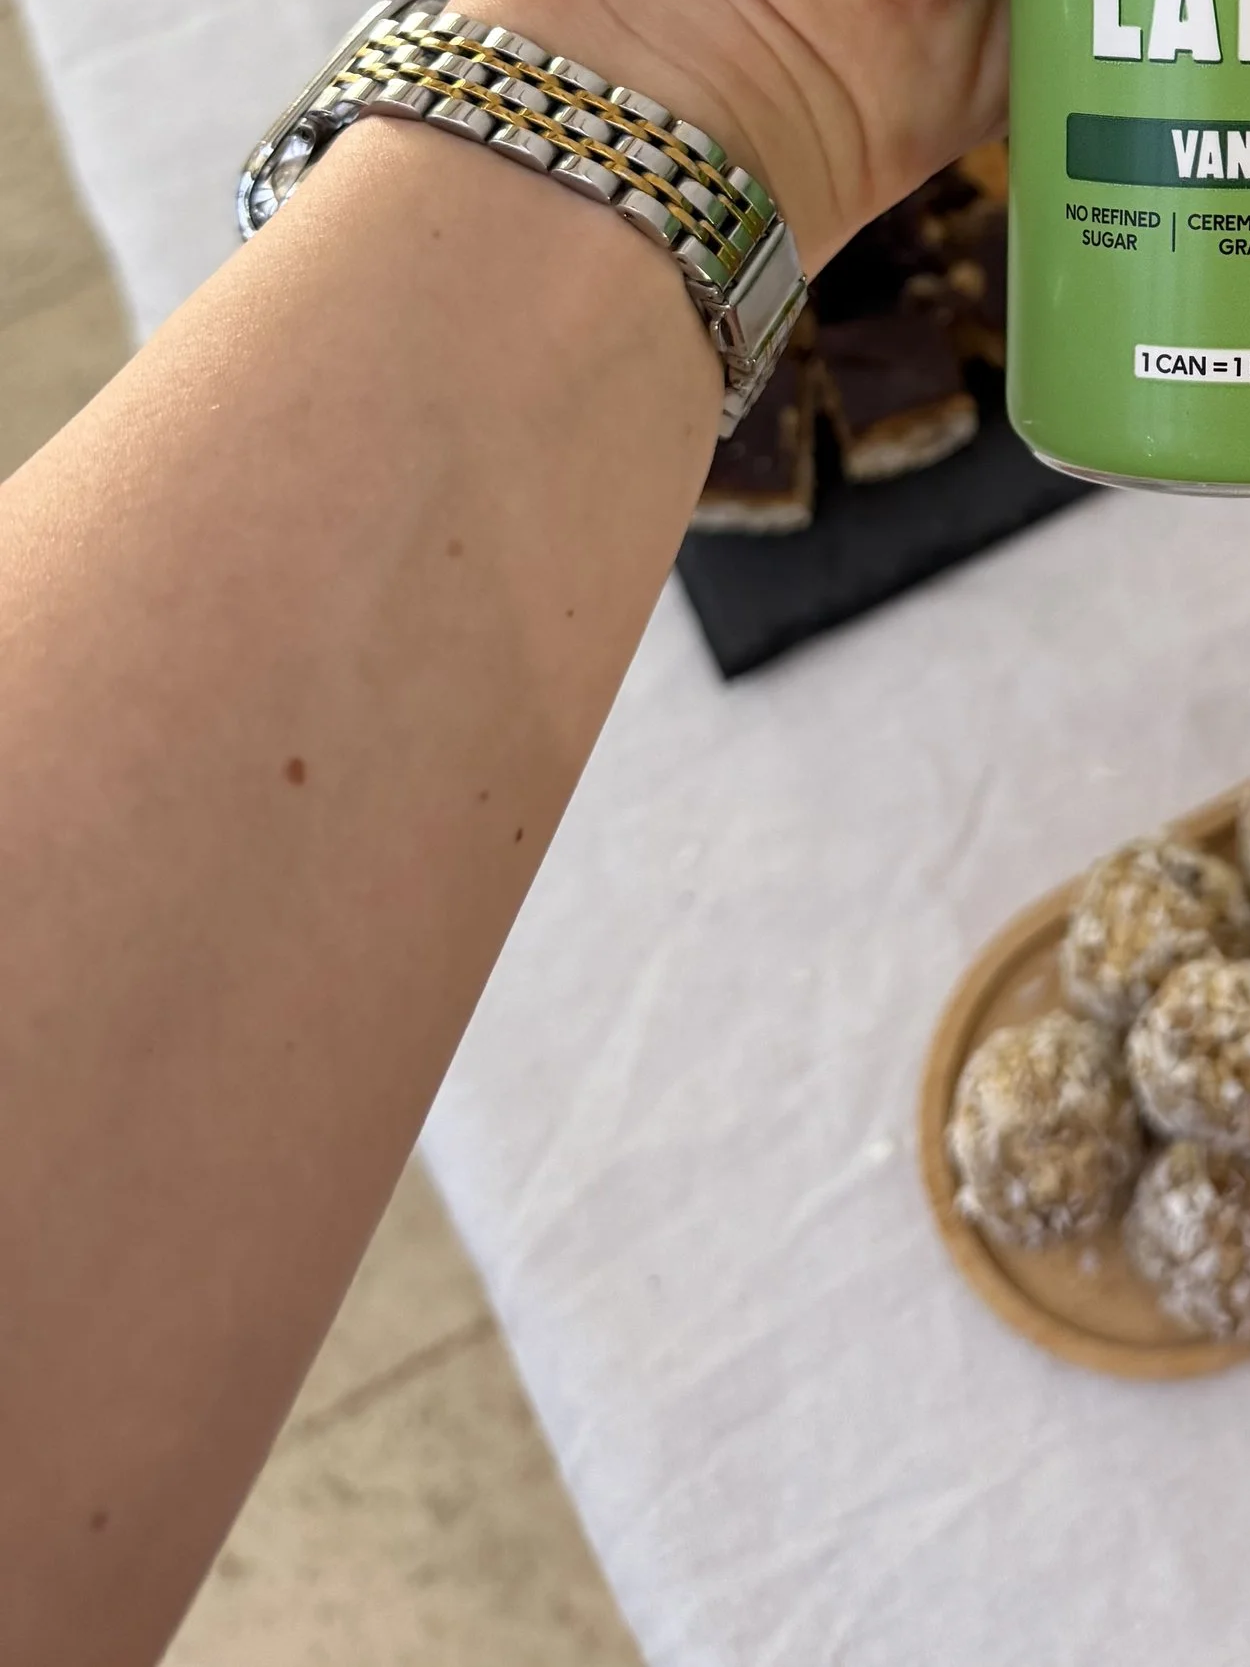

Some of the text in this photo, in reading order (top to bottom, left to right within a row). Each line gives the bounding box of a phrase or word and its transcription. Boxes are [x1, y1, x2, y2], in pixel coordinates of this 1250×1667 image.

[1065, 203, 1162, 229] NO REFINED
[1081, 230, 1138, 251] SUGAR
[1141, 352, 1150, 372] 1
[1155, 353, 1207, 376] CAN
[1233, 356, 1242, 377] 1
